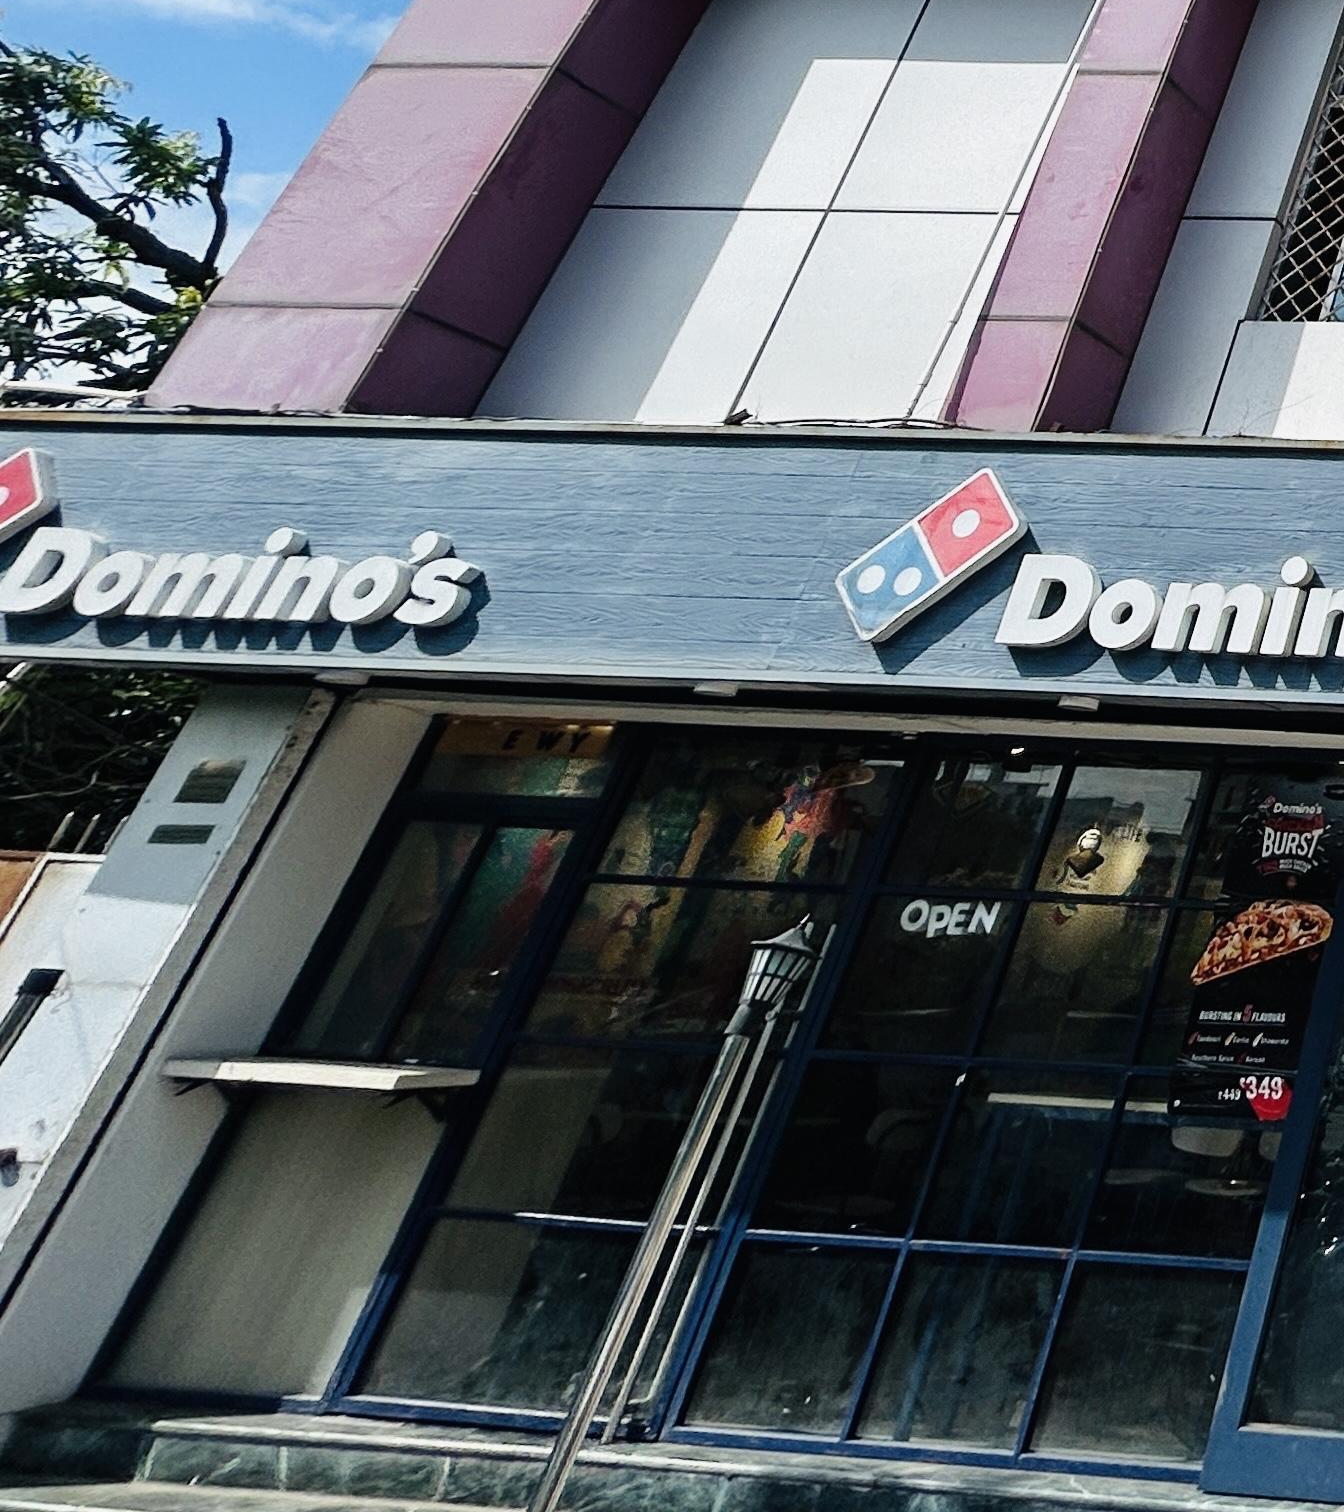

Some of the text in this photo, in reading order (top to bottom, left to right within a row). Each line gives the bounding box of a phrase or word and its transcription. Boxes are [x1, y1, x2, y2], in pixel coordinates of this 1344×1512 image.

[2, 526, 484, 628] Domino's
[1272, 802, 1323, 816] Domino's
[1261, 825, 1324, 859] BURST
[900, 898, 1001, 939] OPEN
